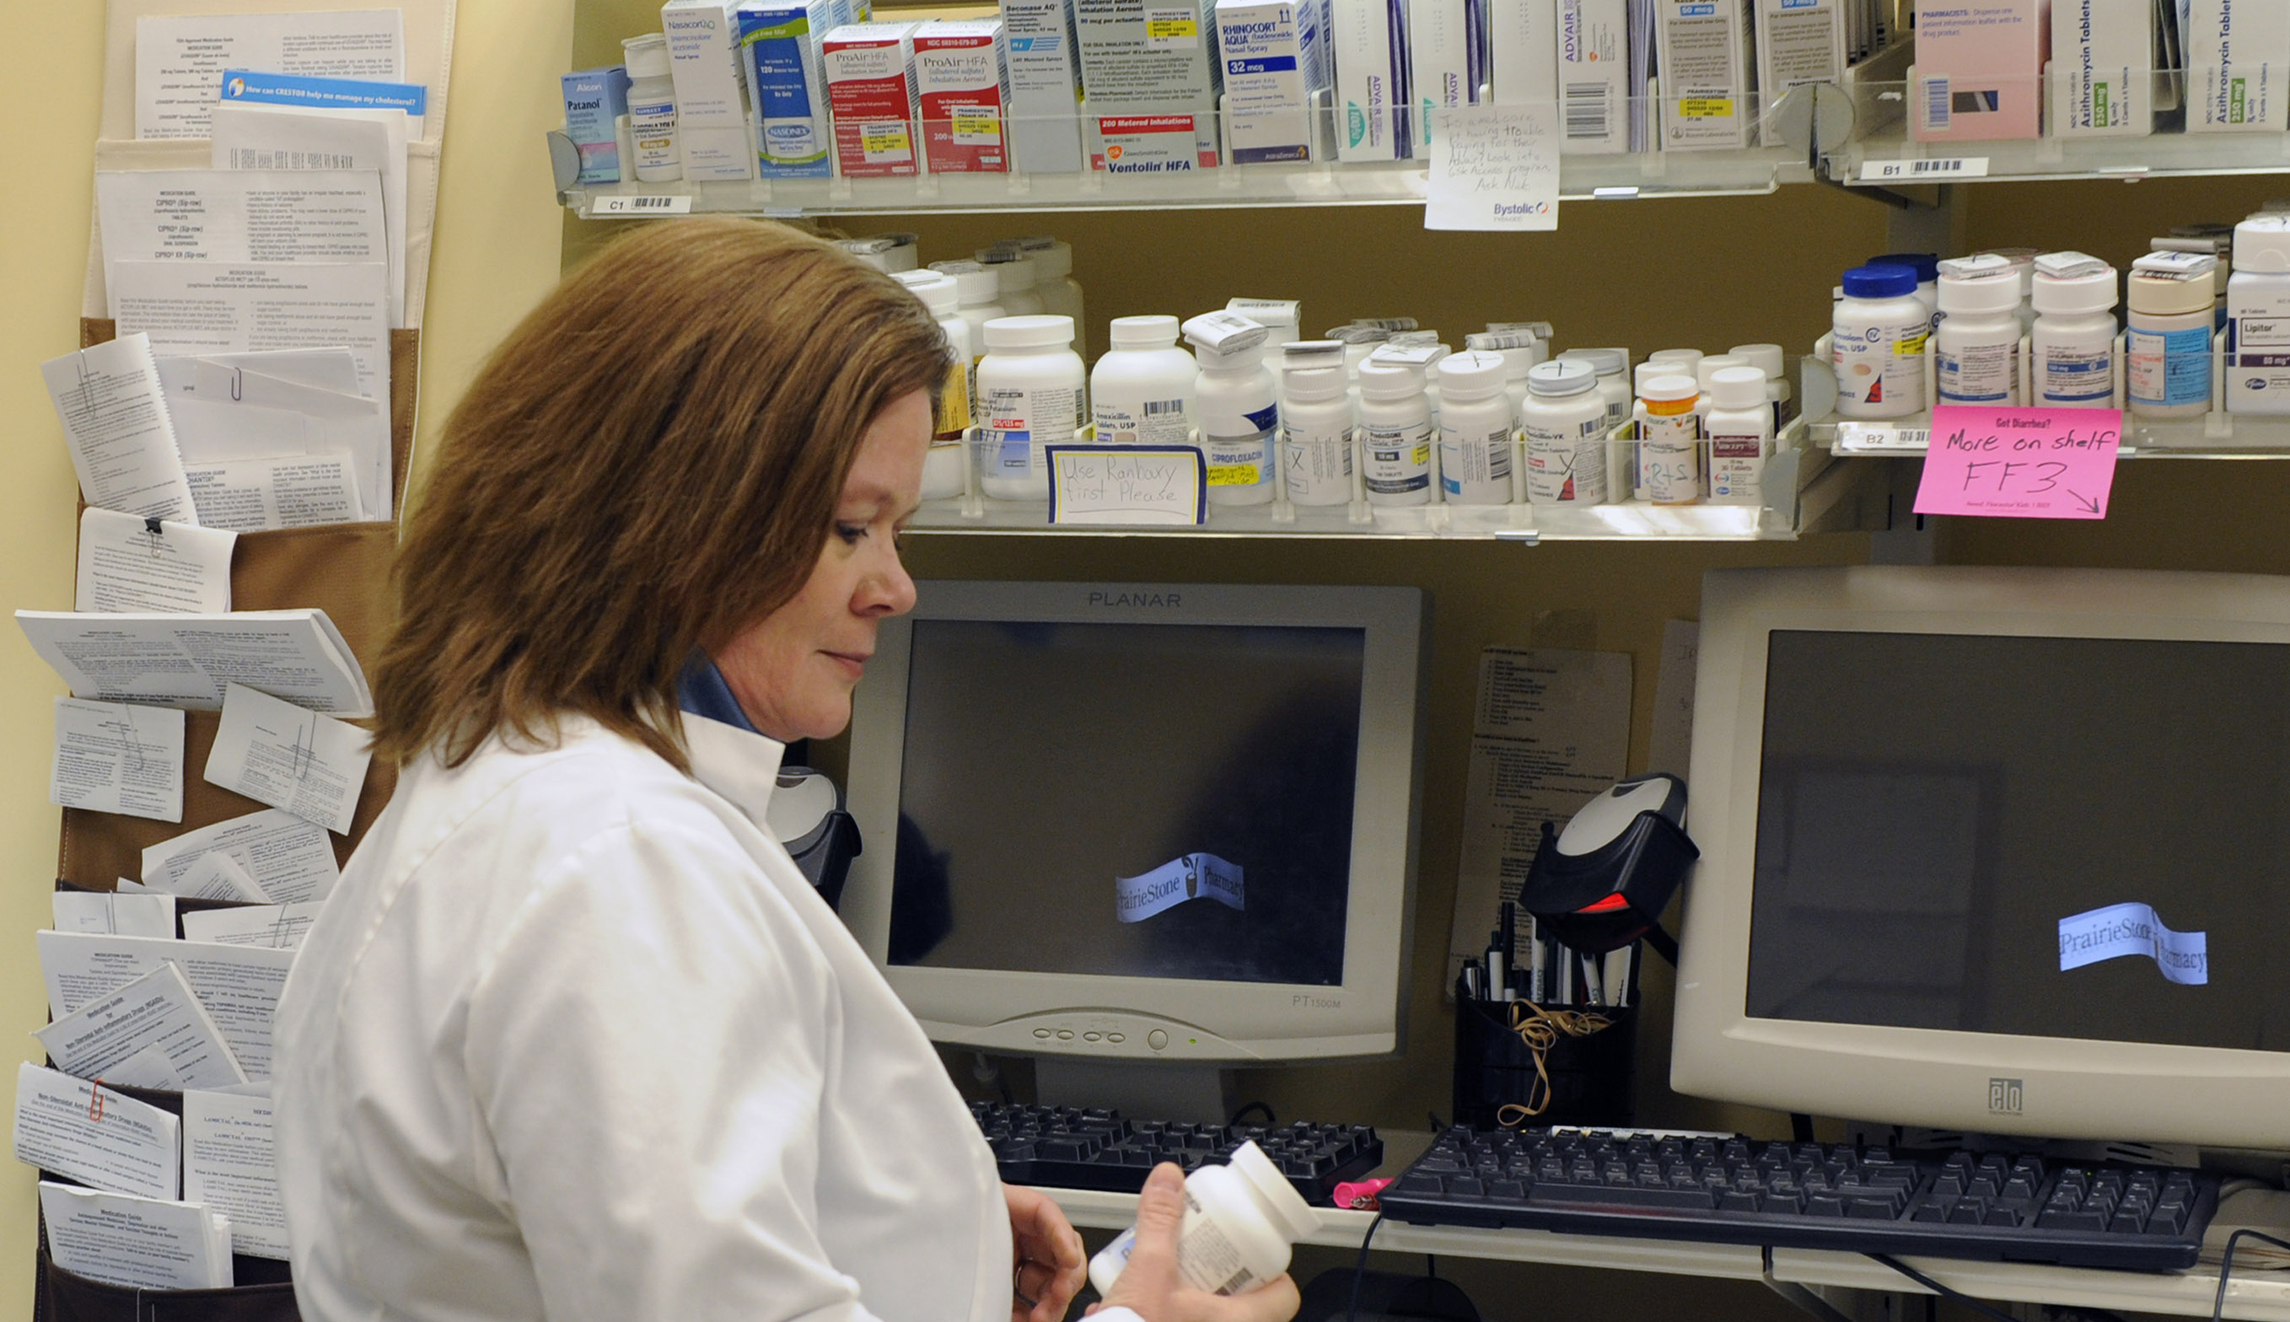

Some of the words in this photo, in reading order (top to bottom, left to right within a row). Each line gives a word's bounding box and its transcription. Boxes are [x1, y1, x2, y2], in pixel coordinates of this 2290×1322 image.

[1694, 6, 1715, 14] mcg
[1973, 8, 2001, 16] Dispense
[1222, 21, 1277, 34] RHINOCORT
[1922, 21, 1942, 29] patient
[1943, 19, 1977, 27] information
[2079, 0, 2091, 44] Tablets
[1564, 12, 1575, 62] ADVAIR
[1922, 30, 1937, 38] drug
[1937, 29, 1961, 37] product.
[1224, 34, 1249, 46] AQUA
[1225, 44, 1246, 54] Nasal
[1246, 44, 1268, 54] Spray
[836, 53, 871, 62] ProAir
[870, 52, 889, 61] HFA
[924, 57, 961, 67] ProAir
[965, 56, 989, 66] HFA
[760, 66, 773, 74] 120
[928, 67, 959, 76] (albuterol
[960, 66, 985, 75] sulfate)
[1230, 61, 1246, 73] 32
[1246, 64, 1264, 74] mcg
[928, 76, 961, 84] Inhalation
[961, 75, 987, 83] Aerosol
[2217, 41, 2232, 123] Azithromycin
[577, 83, 603, 93] Alcon
[2080, 46, 2093, 127] Azithromycin
[246, 86, 262, 94] How
[275, 88, 306, 98] CRESTOR
[306, 90, 323, 100] help
[334, 93, 363, 104] manage
[363, 95, 375, 105] my
[375, 96, 416, 107] cholesterol?
[1273, 94, 1285, 102] Only
[568, 100, 600, 111] Patanol
[2112, 101, 2120, 117] only
[2232, 101, 2243, 122] 250
[2247, 98, 2256, 113] only
[1102, 120, 1116, 128] 200
[1117, 119, 1149, 127] Metered
[1149, 117, 1191, 126] Inhalations
[769, 127, 808, 137] NASONEX
[933, 132, 947, 141] 200
[1503, 124, 1545, 137] trouble
[1449, 138, 1485, 157] paying
[1490, 138, 1508, 148] for
[1512, 138, 1537, 148] their
[1265, 152, 1299, 160] AstraZeneca
[1108, 161, 1162, 173] Ventolin
[1166, 160, 1191, 171] HFA
[1882, 164, 1901, 176] B1
[1474, 177, 1499, 192] Ask
[609, 200, 624, 210] C1
[1494, 203, 1534, 216] Bystolic
[2244, 323, 2273, 333] Lipitor
[1850, 345, 1868, 353] USP
[1119, 421, 1136, 429] USP
[1995, 417, 2011, 429] Got
[2012, 418, 2052, 430] Diarrhea?
[1866, 433, 1885, 444] B2
[1946, 428, 1999, 451] More
[2013, 437, 2042, 451] on
[2051, 428, 2117, 451] shelf
[1212, 451, 1264, 464] CIPROFLOXACIN
[1062, 457, 1096, 479] Use
[1729, 464, 1753, 472] Tablets
[1963, 460, 2068, 493] FF3
[1119, 481, 1178, 503] Please
[1088, 592, 1182, 609] PLANAR
[86, 1003, 111, 1019] Medication
[109, 996, 125, 1008] Guide
[1291, 995, 1342, 1009] PT1500M
[100, 1208, 127, 1219] Medication
[128, 1213, 142, 1221] Guide
